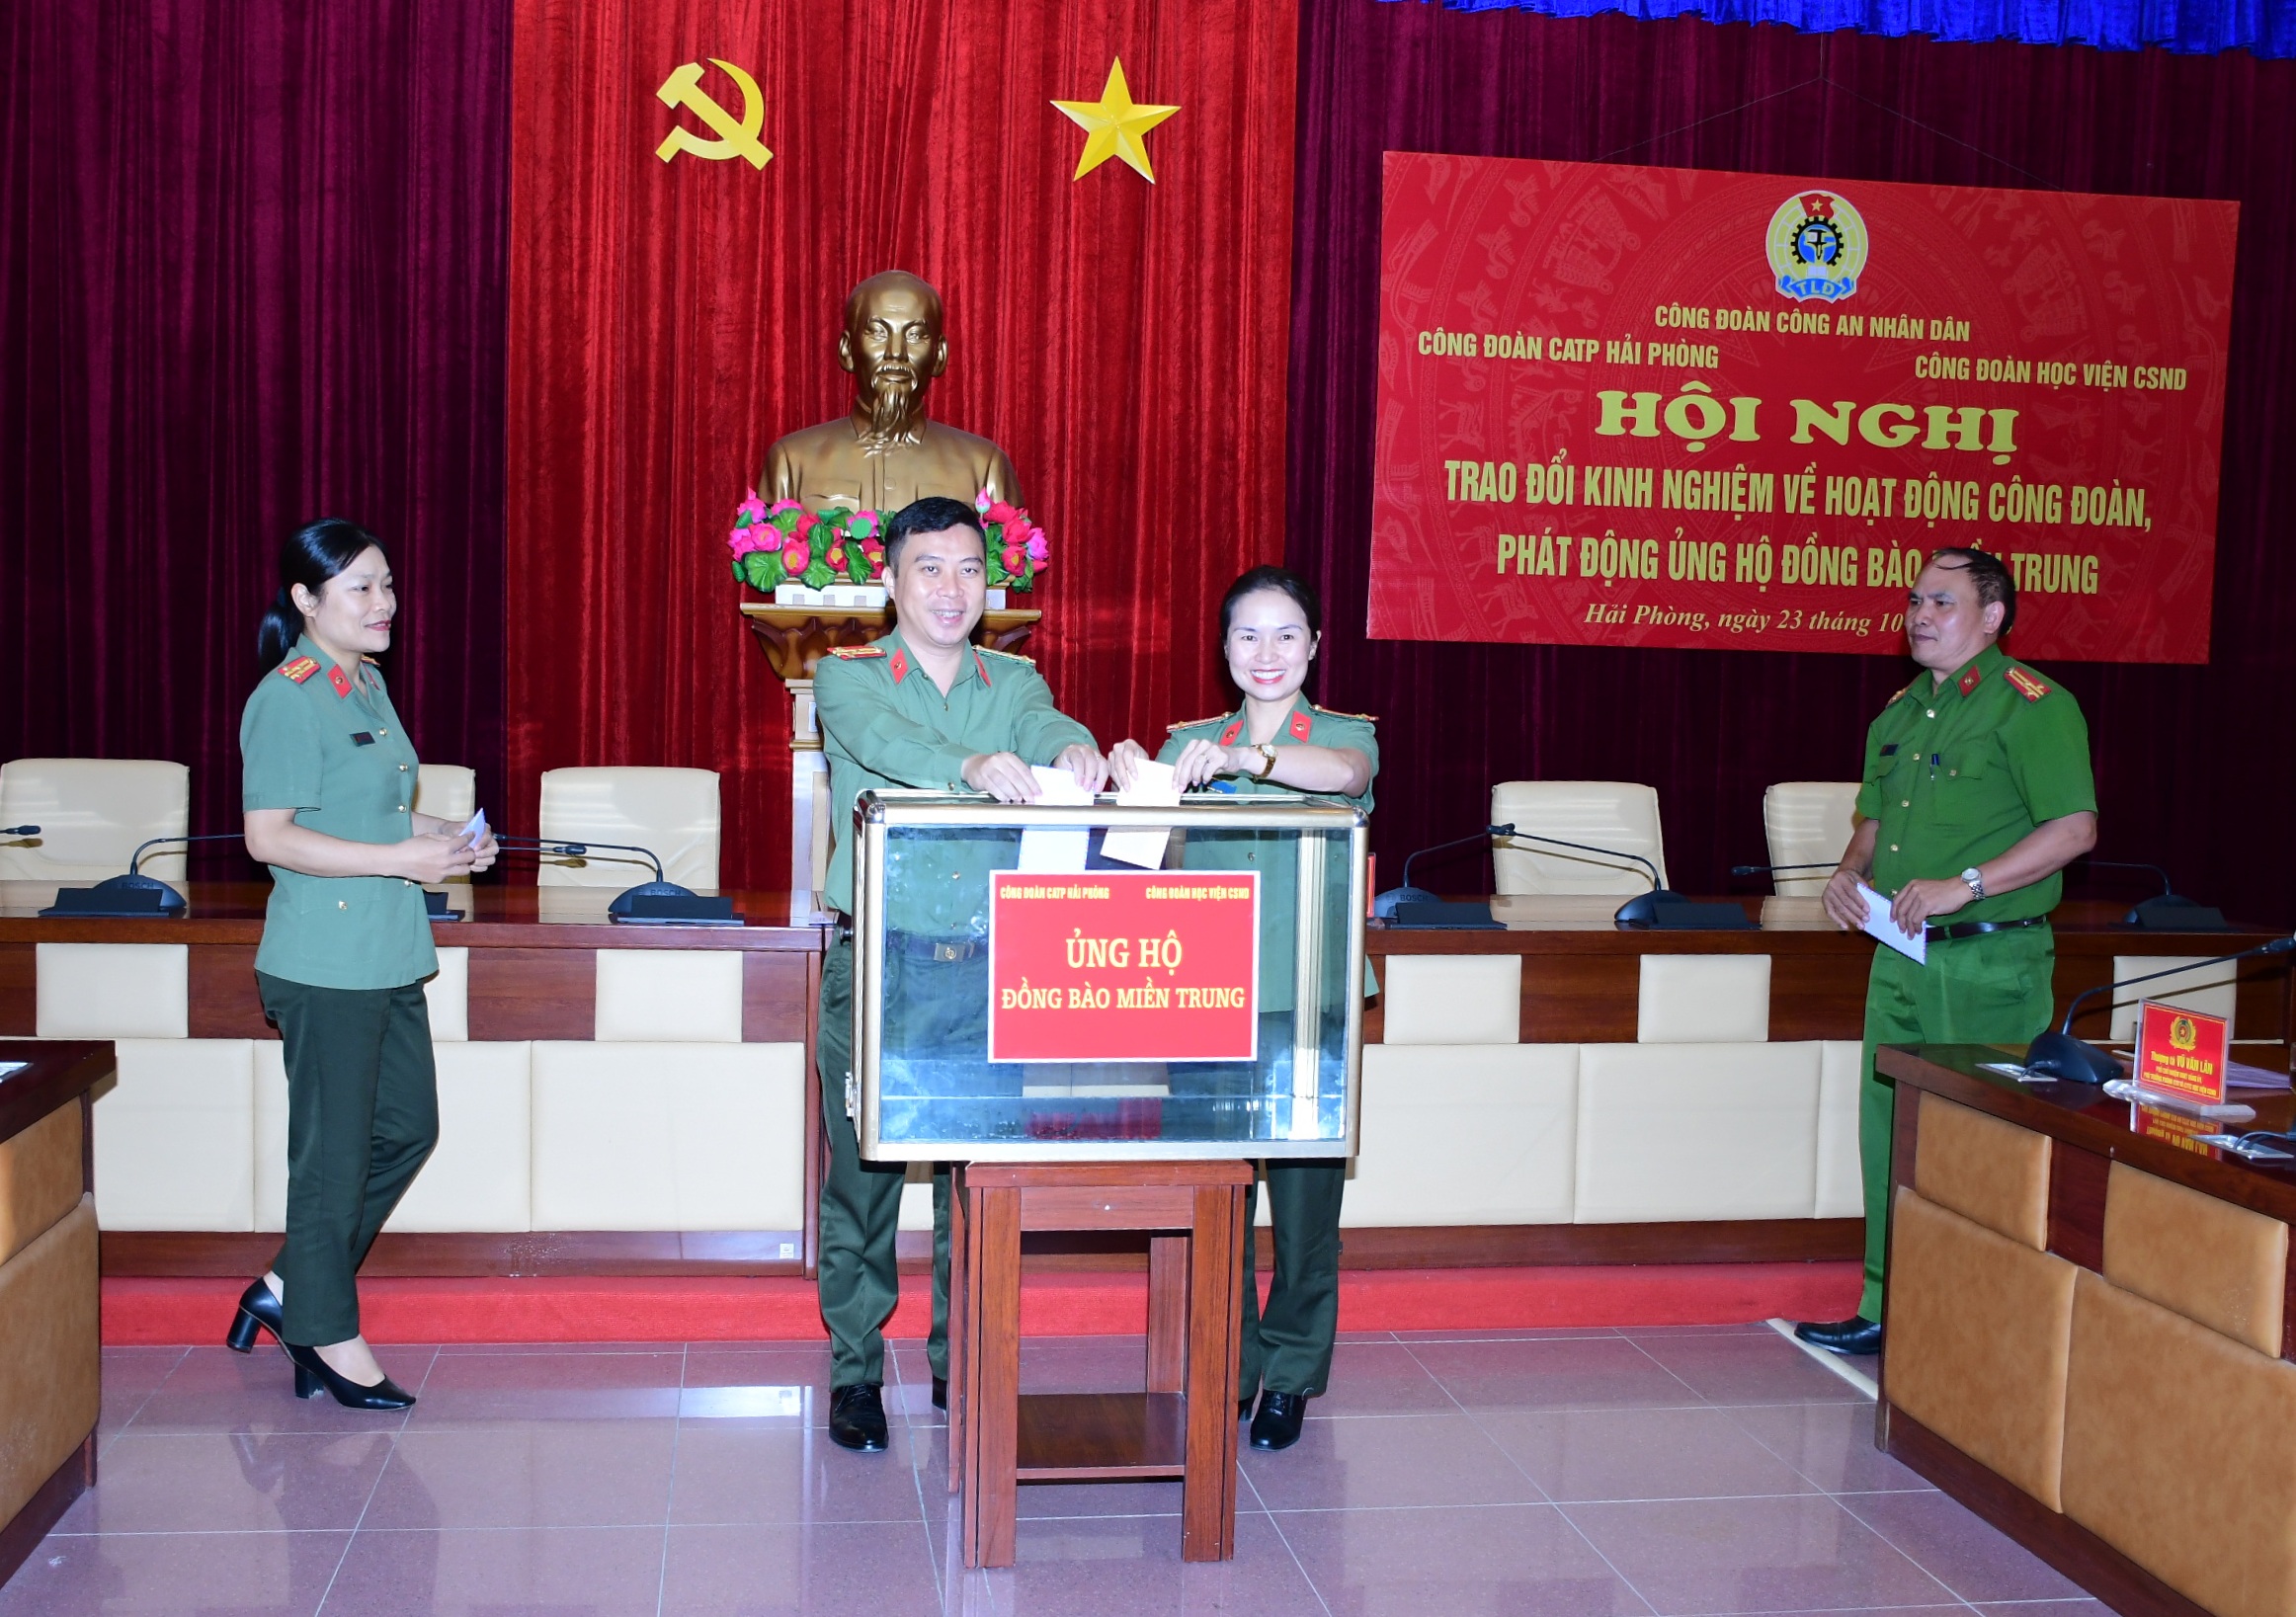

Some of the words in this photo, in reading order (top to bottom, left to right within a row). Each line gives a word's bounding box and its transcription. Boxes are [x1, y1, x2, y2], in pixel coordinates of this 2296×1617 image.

[1797, 281, 1835, 295] TLĐ
[1655, 301, 1709, 329] CÔNG
[1716, 305, 1770, 333] ĐOÀN
[1776, 308, 1830, 335] CÔNG
[1836, 315, 1863, 337] AN
[1869, 313, 1924, 340] NHÂN
[1929, 316, 1970, 342] DÂN
[1418, 327, 1477, 357] CÔNG
[1483, 331, 1542, 361] ĐOÀN
[1549, 338, 1599, 363] CATP
[1605, 333, 1641, 364] HẢI
[1648, 338, 1719, 368] PHÒNG
[1915, 351, 1970, 380] CÔNG
[1976, 355, 2031, 384] ĐOÀN
[2037, 362, 2077, 390] HỌC
[2083, 360, 2128, 392] VIỆN
[2133, 366, 2187, 391] CSND
[1595, 380, 1763, 452] HỘI
[1789, 399, 2019, 465] NGHỊ
[1444, 459, 1517, 503] TRAO
[1525, 447, 1575, 505] ĐỔI
[1583, 465, 1653, 508] KINH
[1662, 463, 1773, 521] NGHIỆM
[1783, 461, 1817, 515] VỀ
[1825, 475, 1897, 526] HOẠT
[1904, 471, 1979, 527] ĐỘNG
[1988, 475, 2063, 525] CÔNG
[2070, 478, 2152, 531] ĐOÀN,
[1497, 526, 1572, 576] PHÁT
[1580, 529, 1659, 587] ĐỘNG
[1668, 526, 1727, 582] ỦNG
[1735, 535, 1773, 593] HỘ
[1781, 531, 1857, 586] ĐỒNG
[1866, 539, 1922, 588] BÀO
[2010, 552, 2098, 595] TRUNG
[1584, 603, 1626, 624] Hải
[1632, 605, 1710, 631] Phòng,
[1717, 609, 1771, 633] ngày
[1776, 608, 1802, 629] 23
[1809, 609, 1871, 635] tháng
[1879, 614, 1905, 633] 10
[1000, 885, 1022, 899] CÔNG
[1047, 887, 1066, 899] CATP
[1209, 885, 1227, 901] VIỆN
[1066, 928, 1130, 968] ỦNG
[1138, 929, 1183, 976] HỘ
[1002, 976, 1062, 1009] ĐỒNG
[1068, 981, 1110, 1009] BÀO
[1116, 976, 1170, 1009] MIỀN
[1176, 988, 1245, 1009] TRUNG
